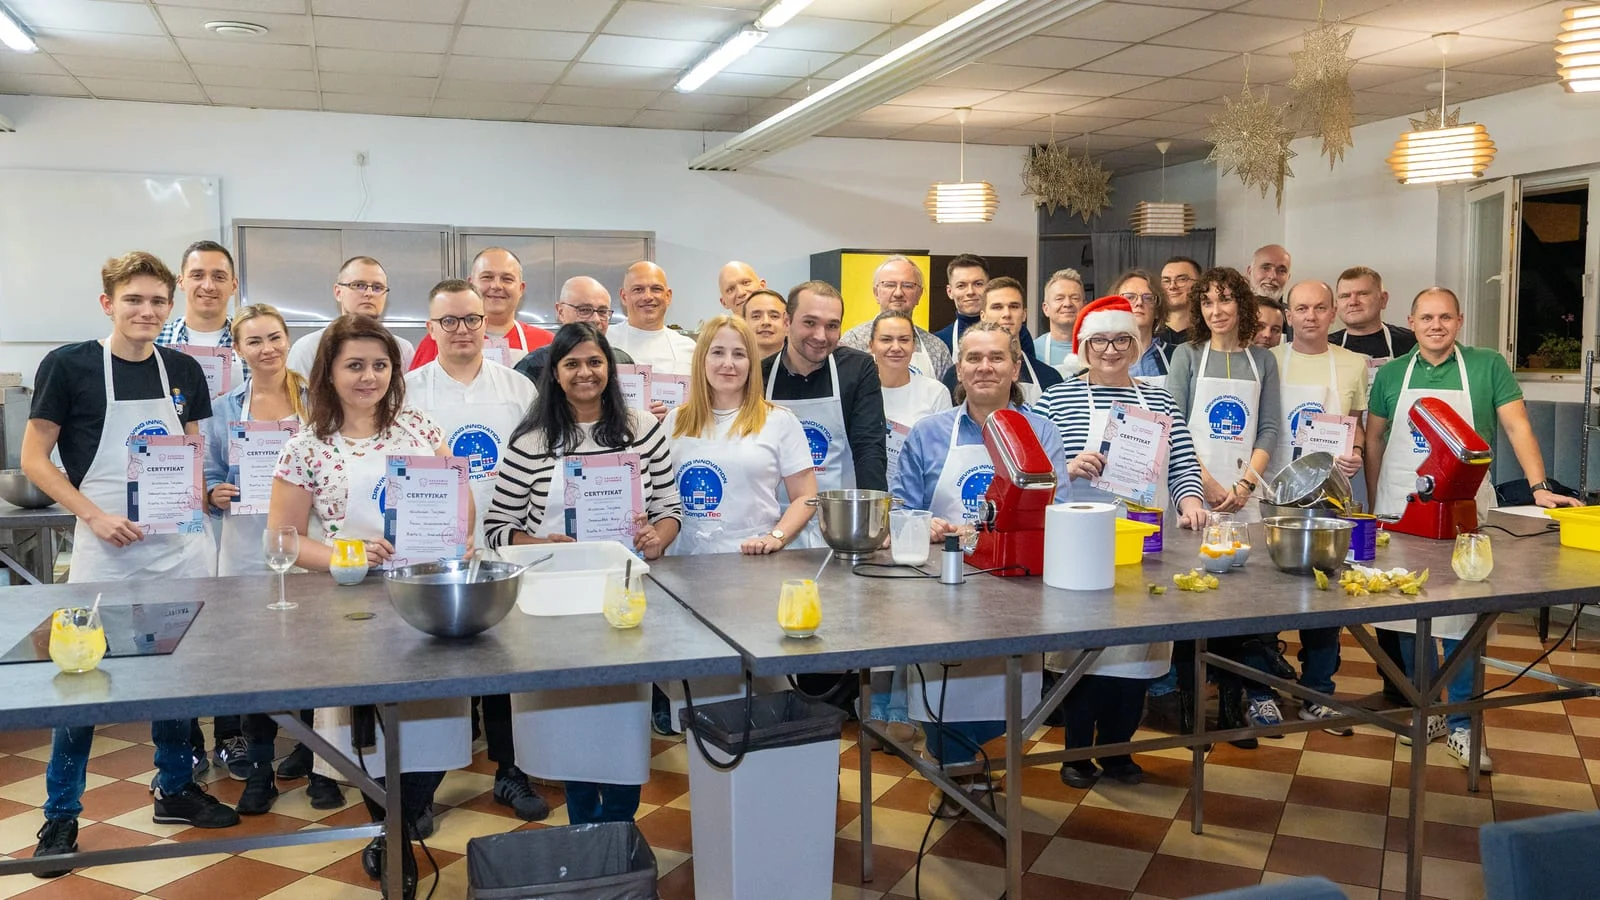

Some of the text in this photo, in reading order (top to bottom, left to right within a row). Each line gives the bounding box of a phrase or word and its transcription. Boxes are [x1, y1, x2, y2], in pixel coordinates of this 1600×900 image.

[1309, 437, 1339, 445] CERTYFIKAT
[469, 471, 499, 480] mpuTec
[583, 489, 623, 497] CERTYFIKAT
